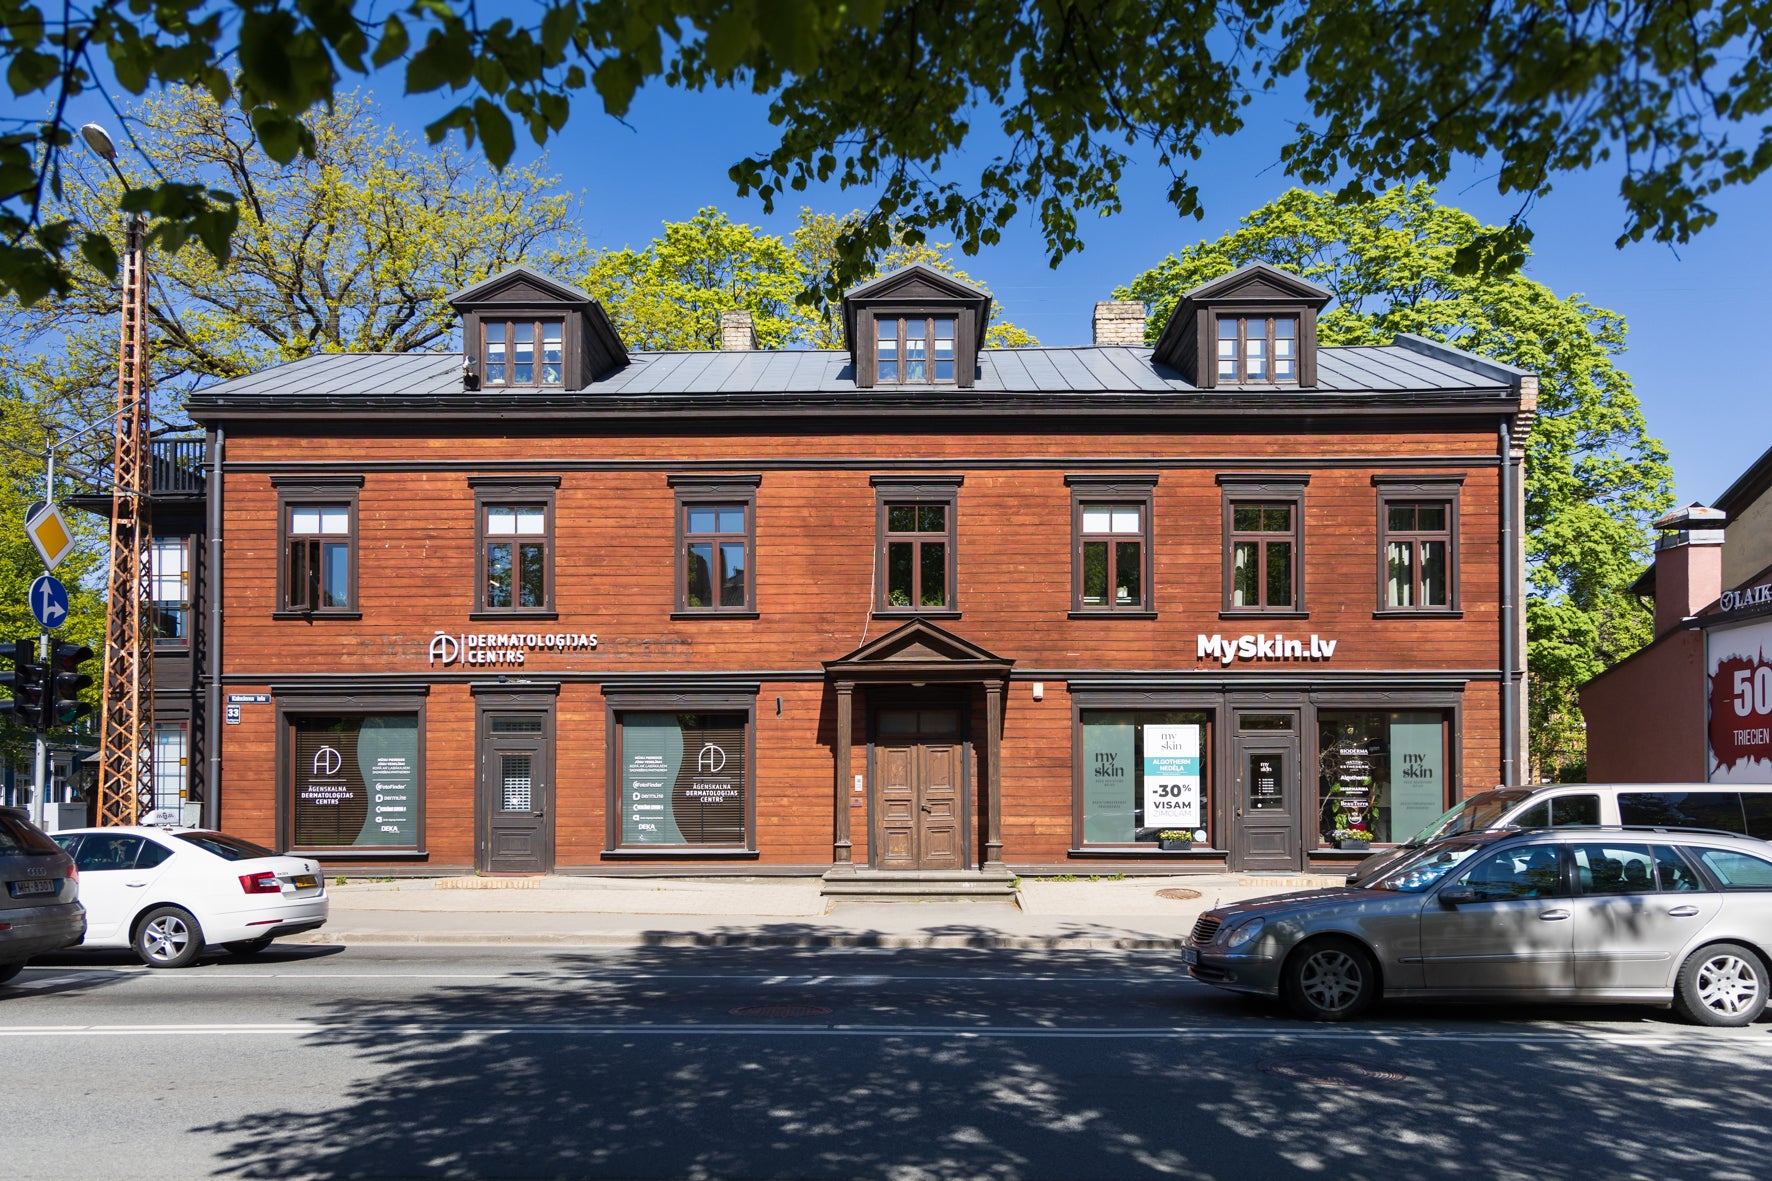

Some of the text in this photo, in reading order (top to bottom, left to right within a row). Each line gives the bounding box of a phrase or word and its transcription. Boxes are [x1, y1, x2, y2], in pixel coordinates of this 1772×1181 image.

[468, 634, 598, 650] DERMATOLOĢIJAS
[1197, 634, 1337, 664] MySkin.lv
[468, 650, 525, 663] CENTRS
[227, 708, 239, 717] 33
[1733, 728, 1770, 746] TRIECIEN
[1161, 741, 1182, 750] skin
[1095, 752, 1118, 765] my
[1403, 753, 1426, 766] my
[1094, 763, 1124, 777] skin
[1402, 764, 1433, 778] skin
[1152, 784, 1191, 798] -30%
[1153, 801, 1191, 809] VISAM
